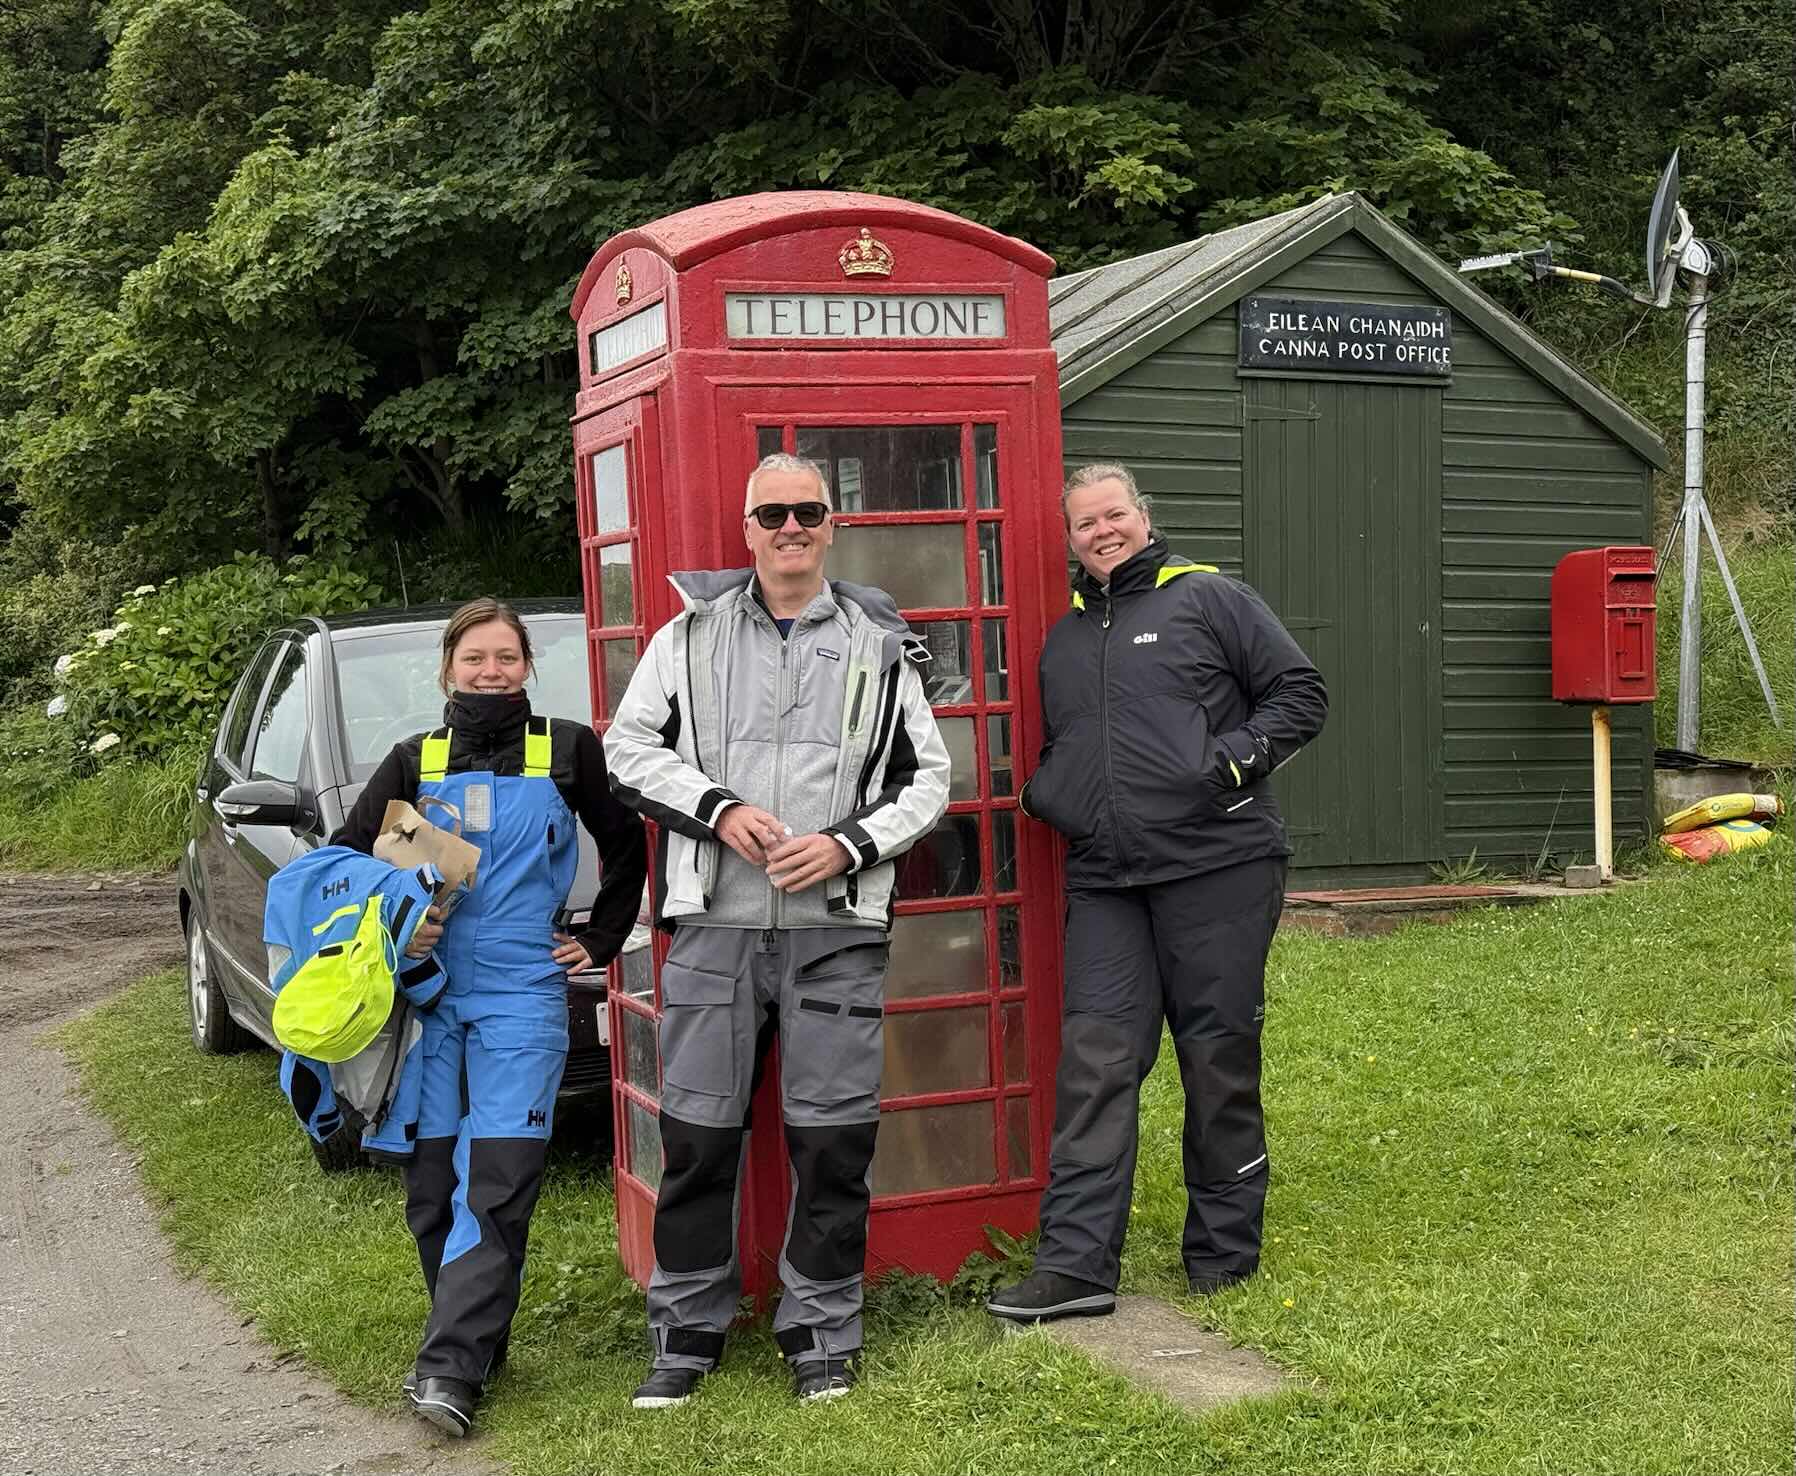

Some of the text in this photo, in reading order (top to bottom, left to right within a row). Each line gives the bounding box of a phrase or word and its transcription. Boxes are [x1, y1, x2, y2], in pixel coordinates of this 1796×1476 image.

[737, 298, 992, 337] TELEPHONE
[1269, 312, 1444, 338] EILEAN CHANAIDH
[1259, 338, 1451, 364] CANNA POST OFFICE
[322, 876, 350, 900] HH
[527, 1109, 546, 1127] HH
